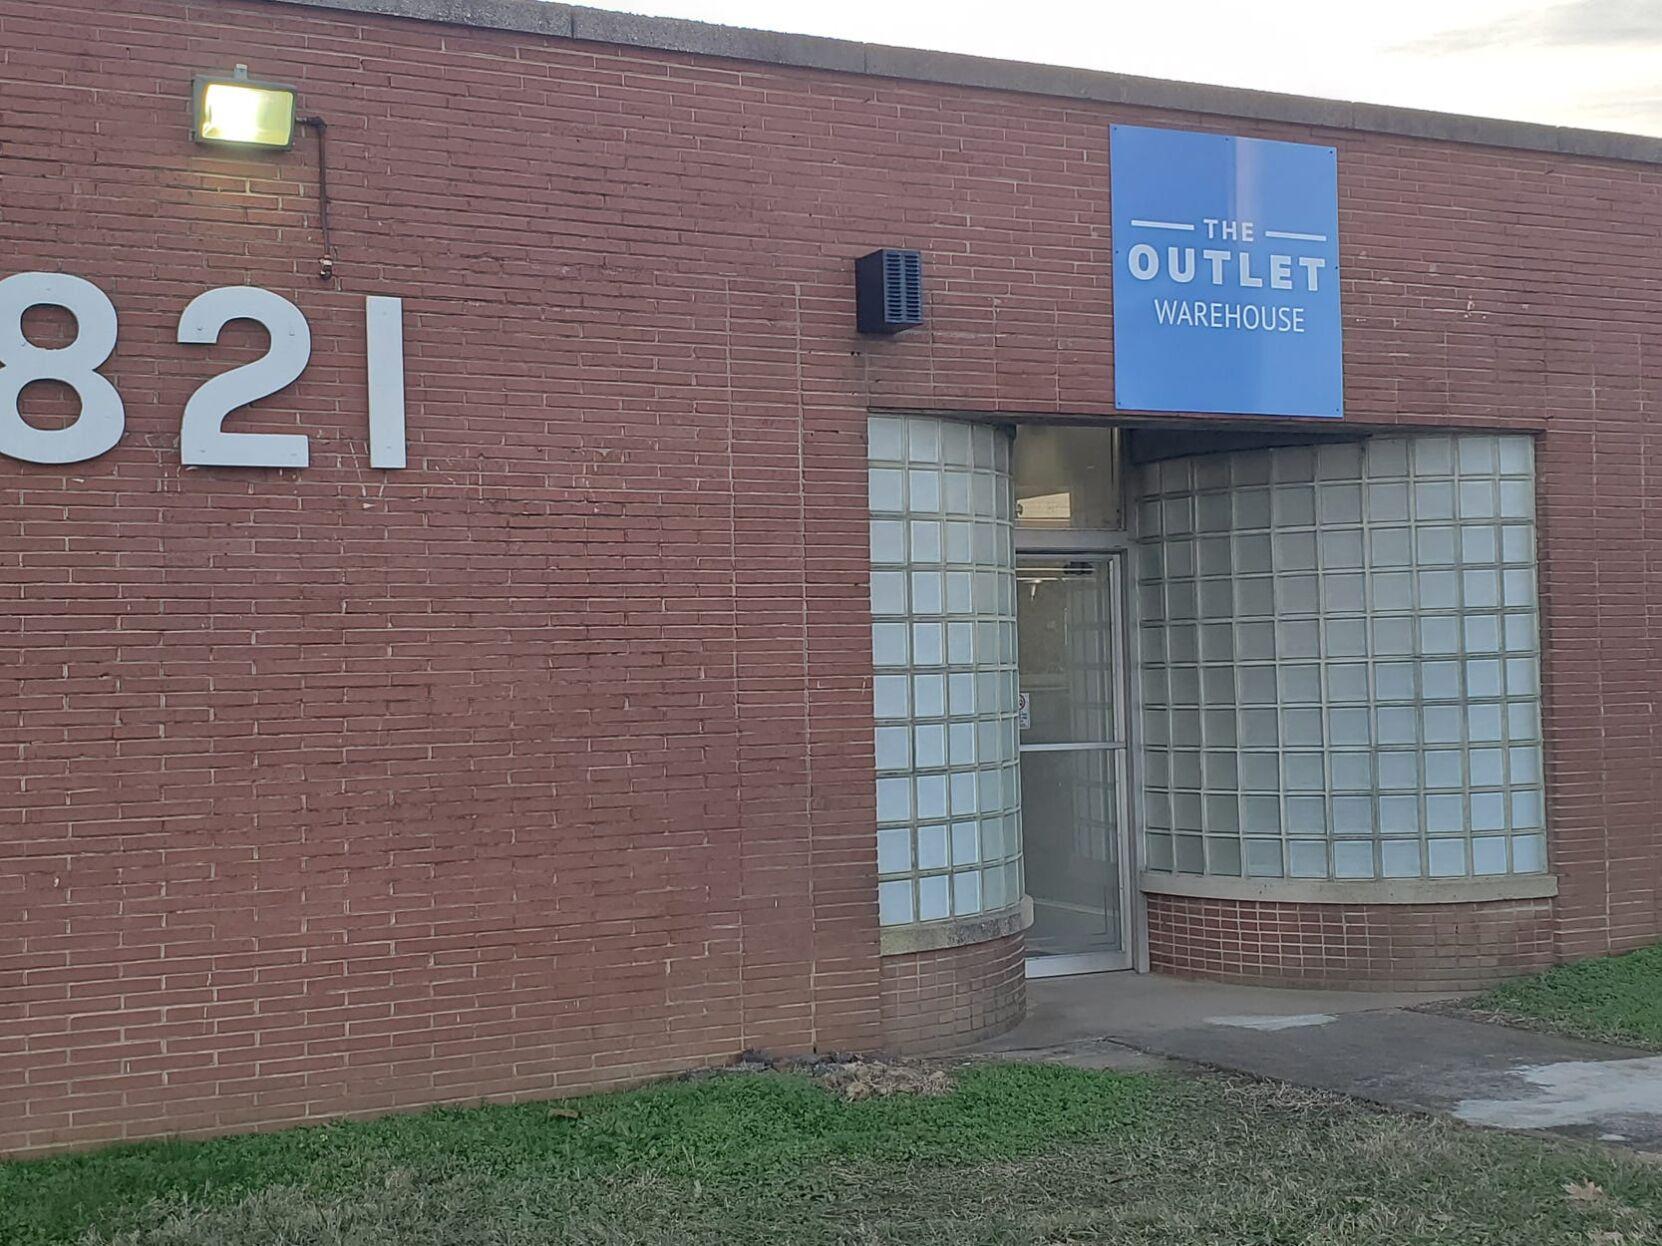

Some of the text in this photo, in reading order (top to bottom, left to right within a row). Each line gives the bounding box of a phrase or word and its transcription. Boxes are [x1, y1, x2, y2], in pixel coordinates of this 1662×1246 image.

[1203, 218, 1254, 242] THE
[1128, 244, 1326, 292] OUTLET
[1154, 299, 1305, 333] WAREHOUSE
[0, 271, 407, 469] 821
